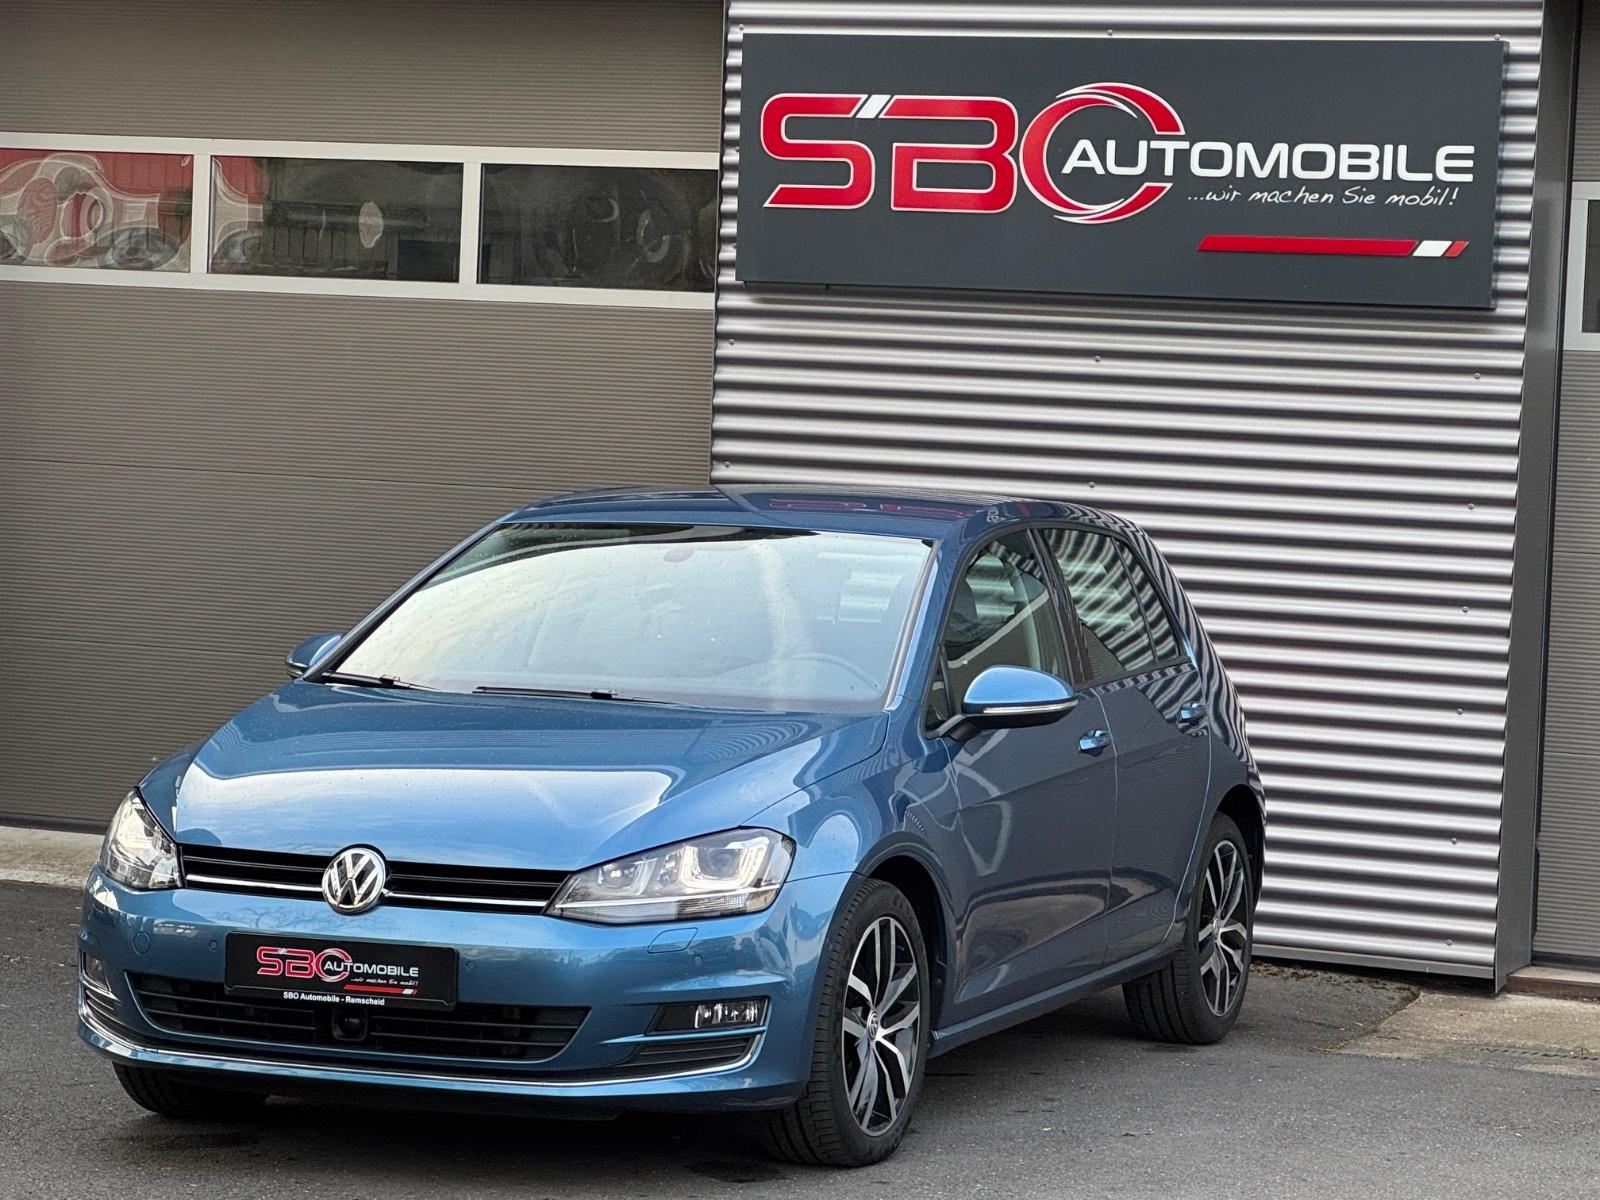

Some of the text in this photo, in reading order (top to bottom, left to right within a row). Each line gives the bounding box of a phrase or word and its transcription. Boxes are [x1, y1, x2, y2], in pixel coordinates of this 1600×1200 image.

[1061, 137, 1475, 185] AUTOMOBILE
[1248, 187, 1335, 205] machen
[1342, 185, 1377, 206] Sie
[1384, 185, 1461, 207] mobil!
[323, 959, 419, 978] AUTOMOBILE
[283, 991, 299, 1000] SBO
[300, 992, 340, 1003] Automobile
[345, 995, 385, 1006] Remscheid
